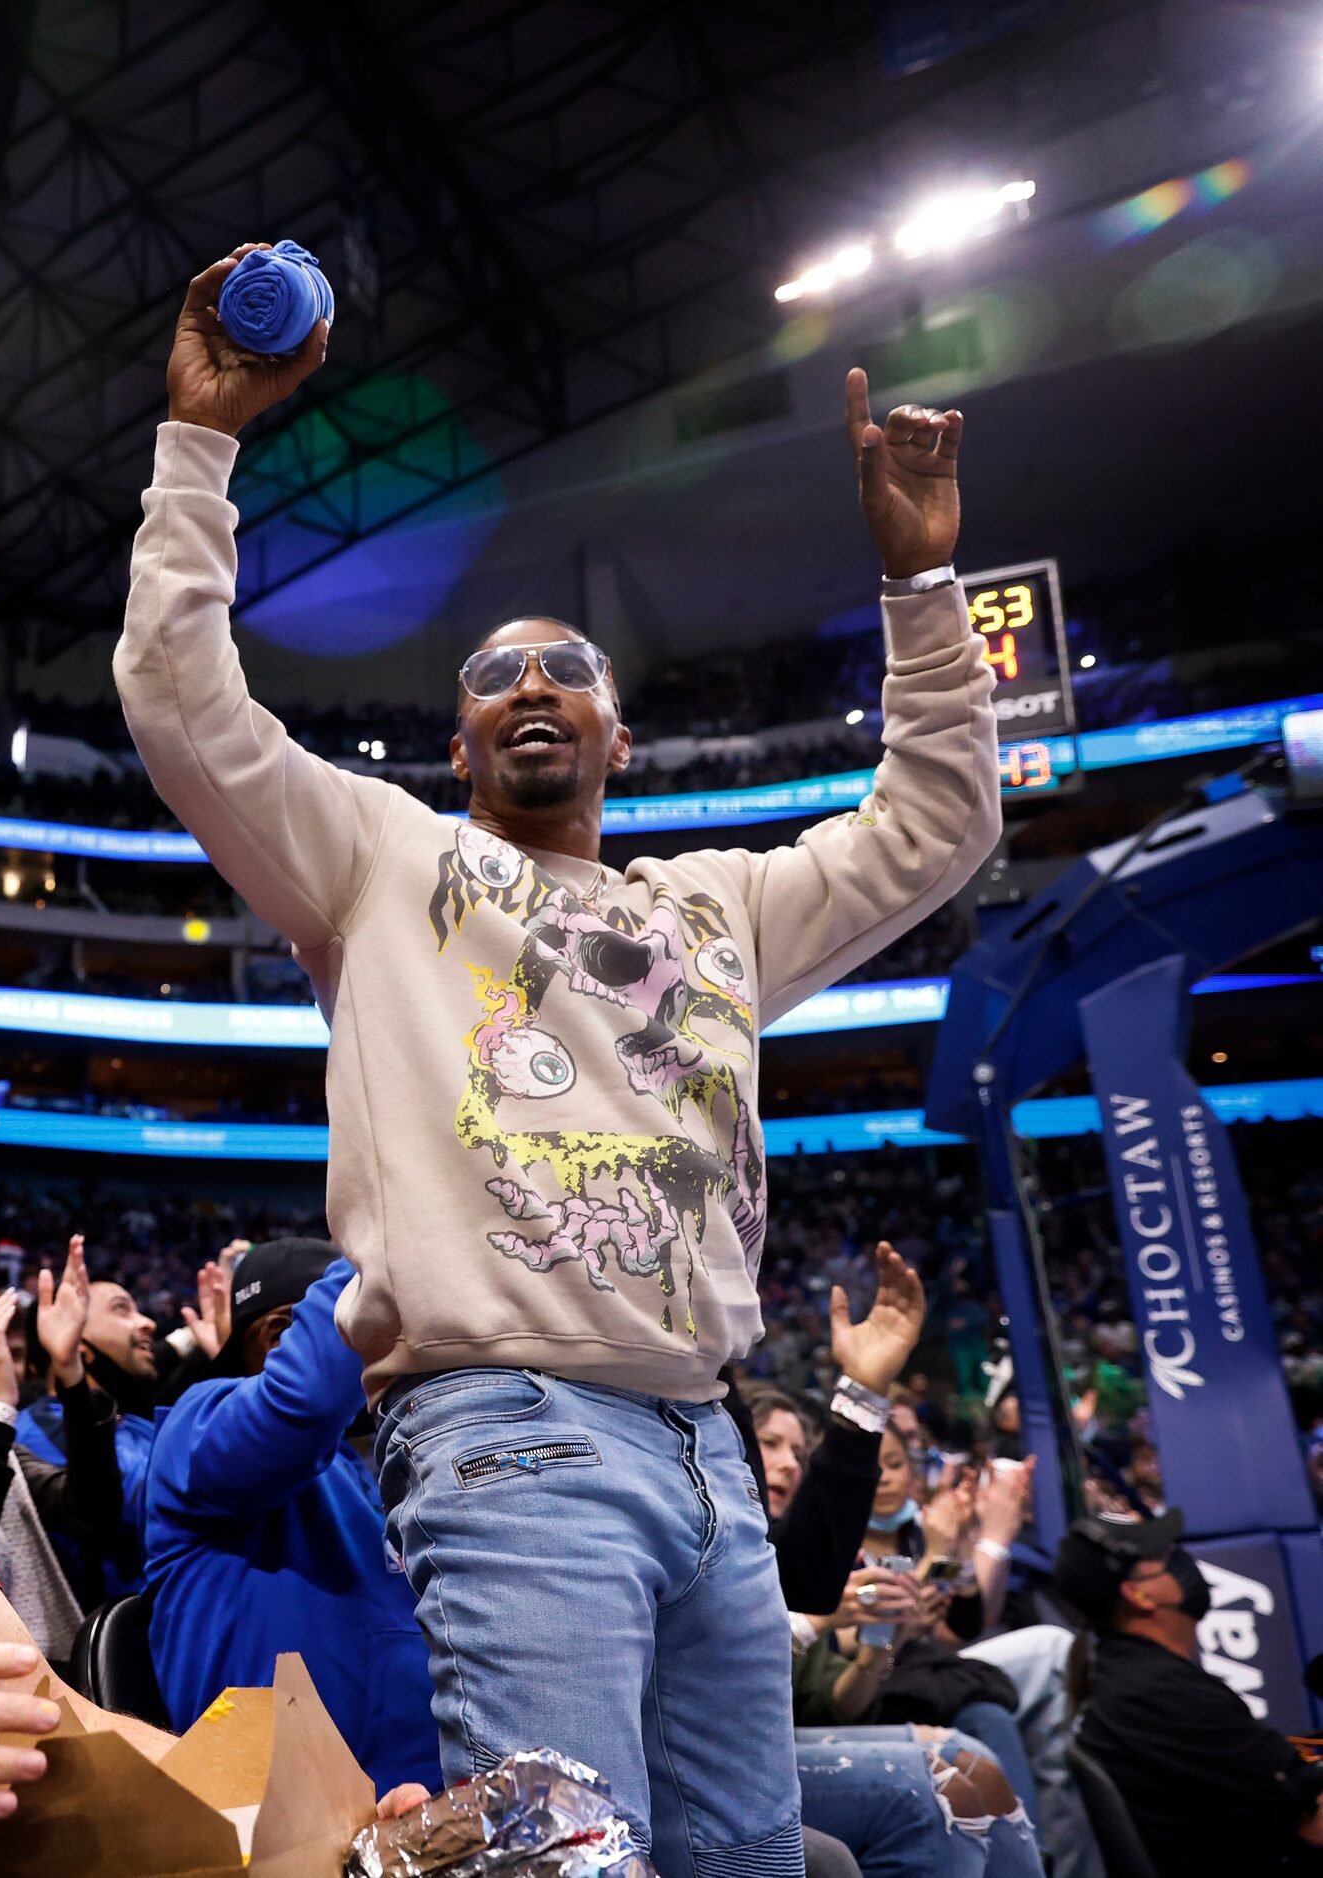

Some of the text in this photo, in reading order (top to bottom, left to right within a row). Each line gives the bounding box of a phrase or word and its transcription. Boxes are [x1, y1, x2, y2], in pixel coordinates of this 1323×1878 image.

[1180, 1104, 1219, 1208] RESORTS
[1109, 1093, 1196, 1368] CHOCTAW
[1204, 1234, 1245, 1342] CASINOS
